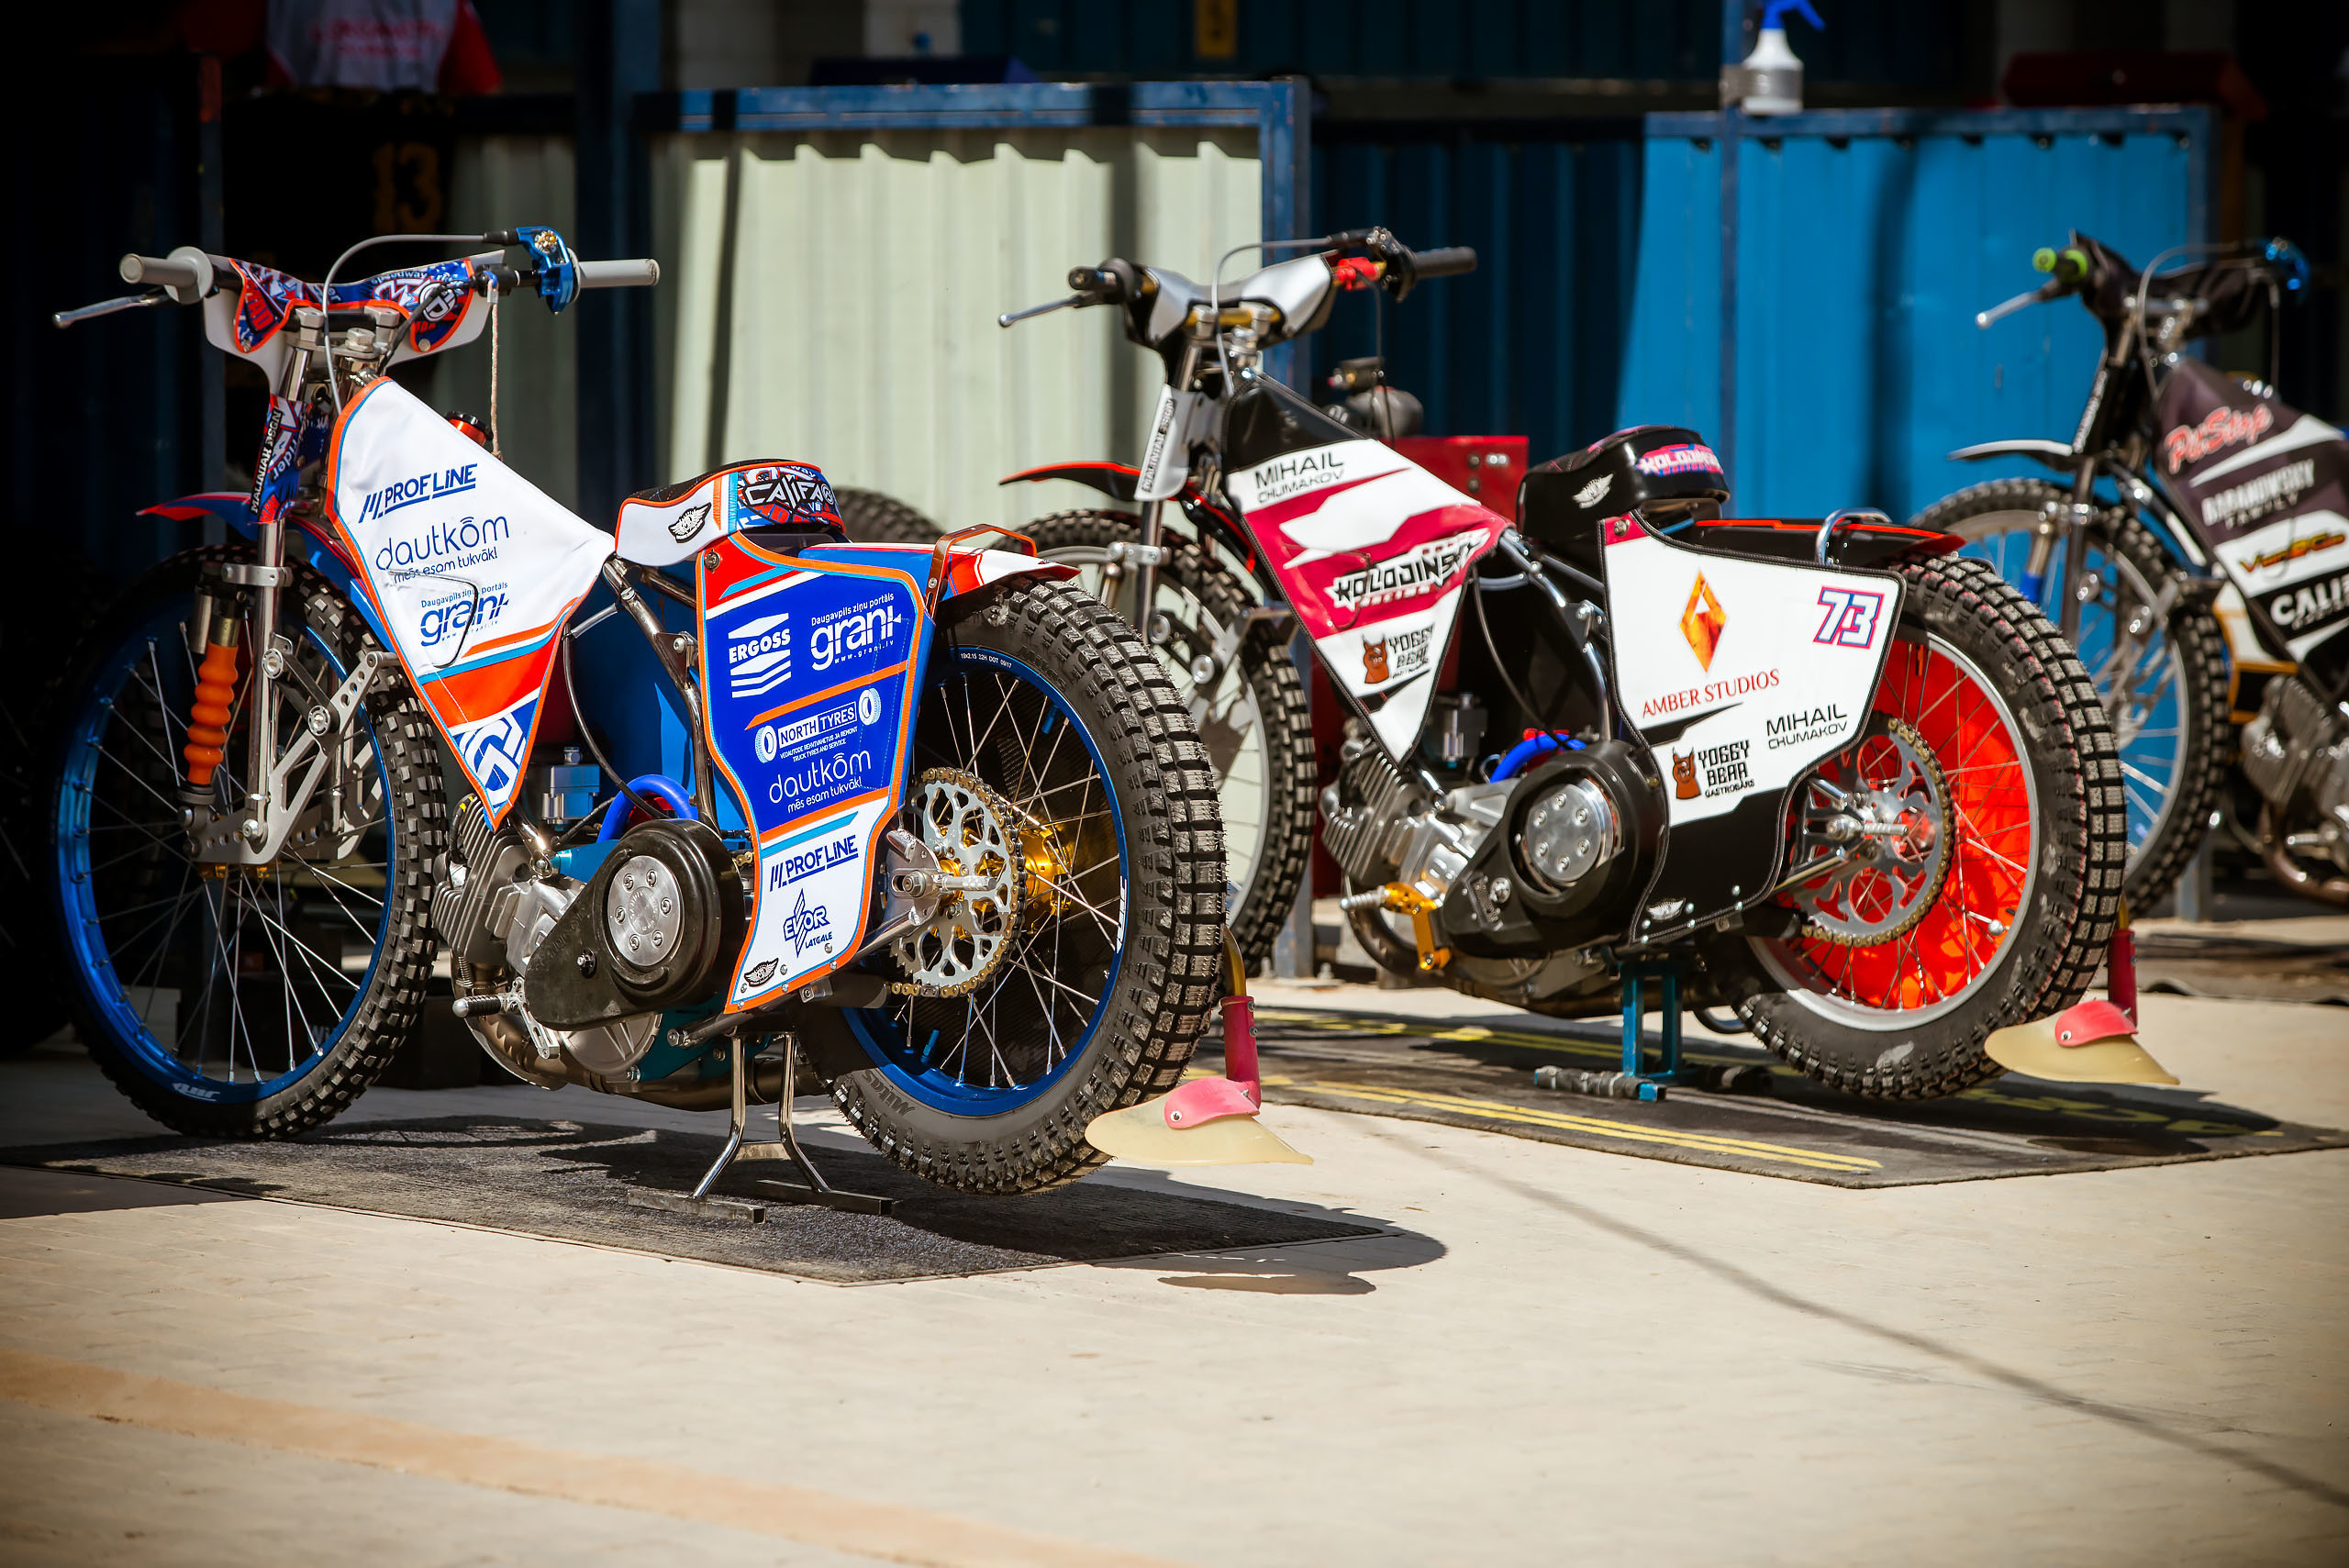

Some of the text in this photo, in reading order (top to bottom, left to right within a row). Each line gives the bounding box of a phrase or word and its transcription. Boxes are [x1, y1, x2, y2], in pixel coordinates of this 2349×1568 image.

[250, 448, 273, 513] MALINIAK
[1255, 450, 1344, 489] MIHAIL
[1258, 469, 1344, 504] CHUMAKOV
[420, 593, 462, 608] Daugavpils
[462, 588, 479, 600] ziņ
[811, 606, 852, 627] Daugavpils
[869, 592, 895, 609] portāls
[1813, 584, 1886, 650] 73
[728, 628, 791, 664] ERGOSS
[1642, 668, 1780, 719] AMBER STUDIOS
[780, 706, 855, 745] NORTH TYRES
[1766, 703, 1848, 737] MIHAIL
[1768, 720, 1848, 751] CHUMAKOV
[1698, 740, 1749, 769] YOGGY
[1707, 762, 1748, 786] BEAR
[787, 775, 863, 814] mēs esam tukvāk!
[783, 899, 830, 947] EVOR
[805, 931, 832, 949] LATGALE
